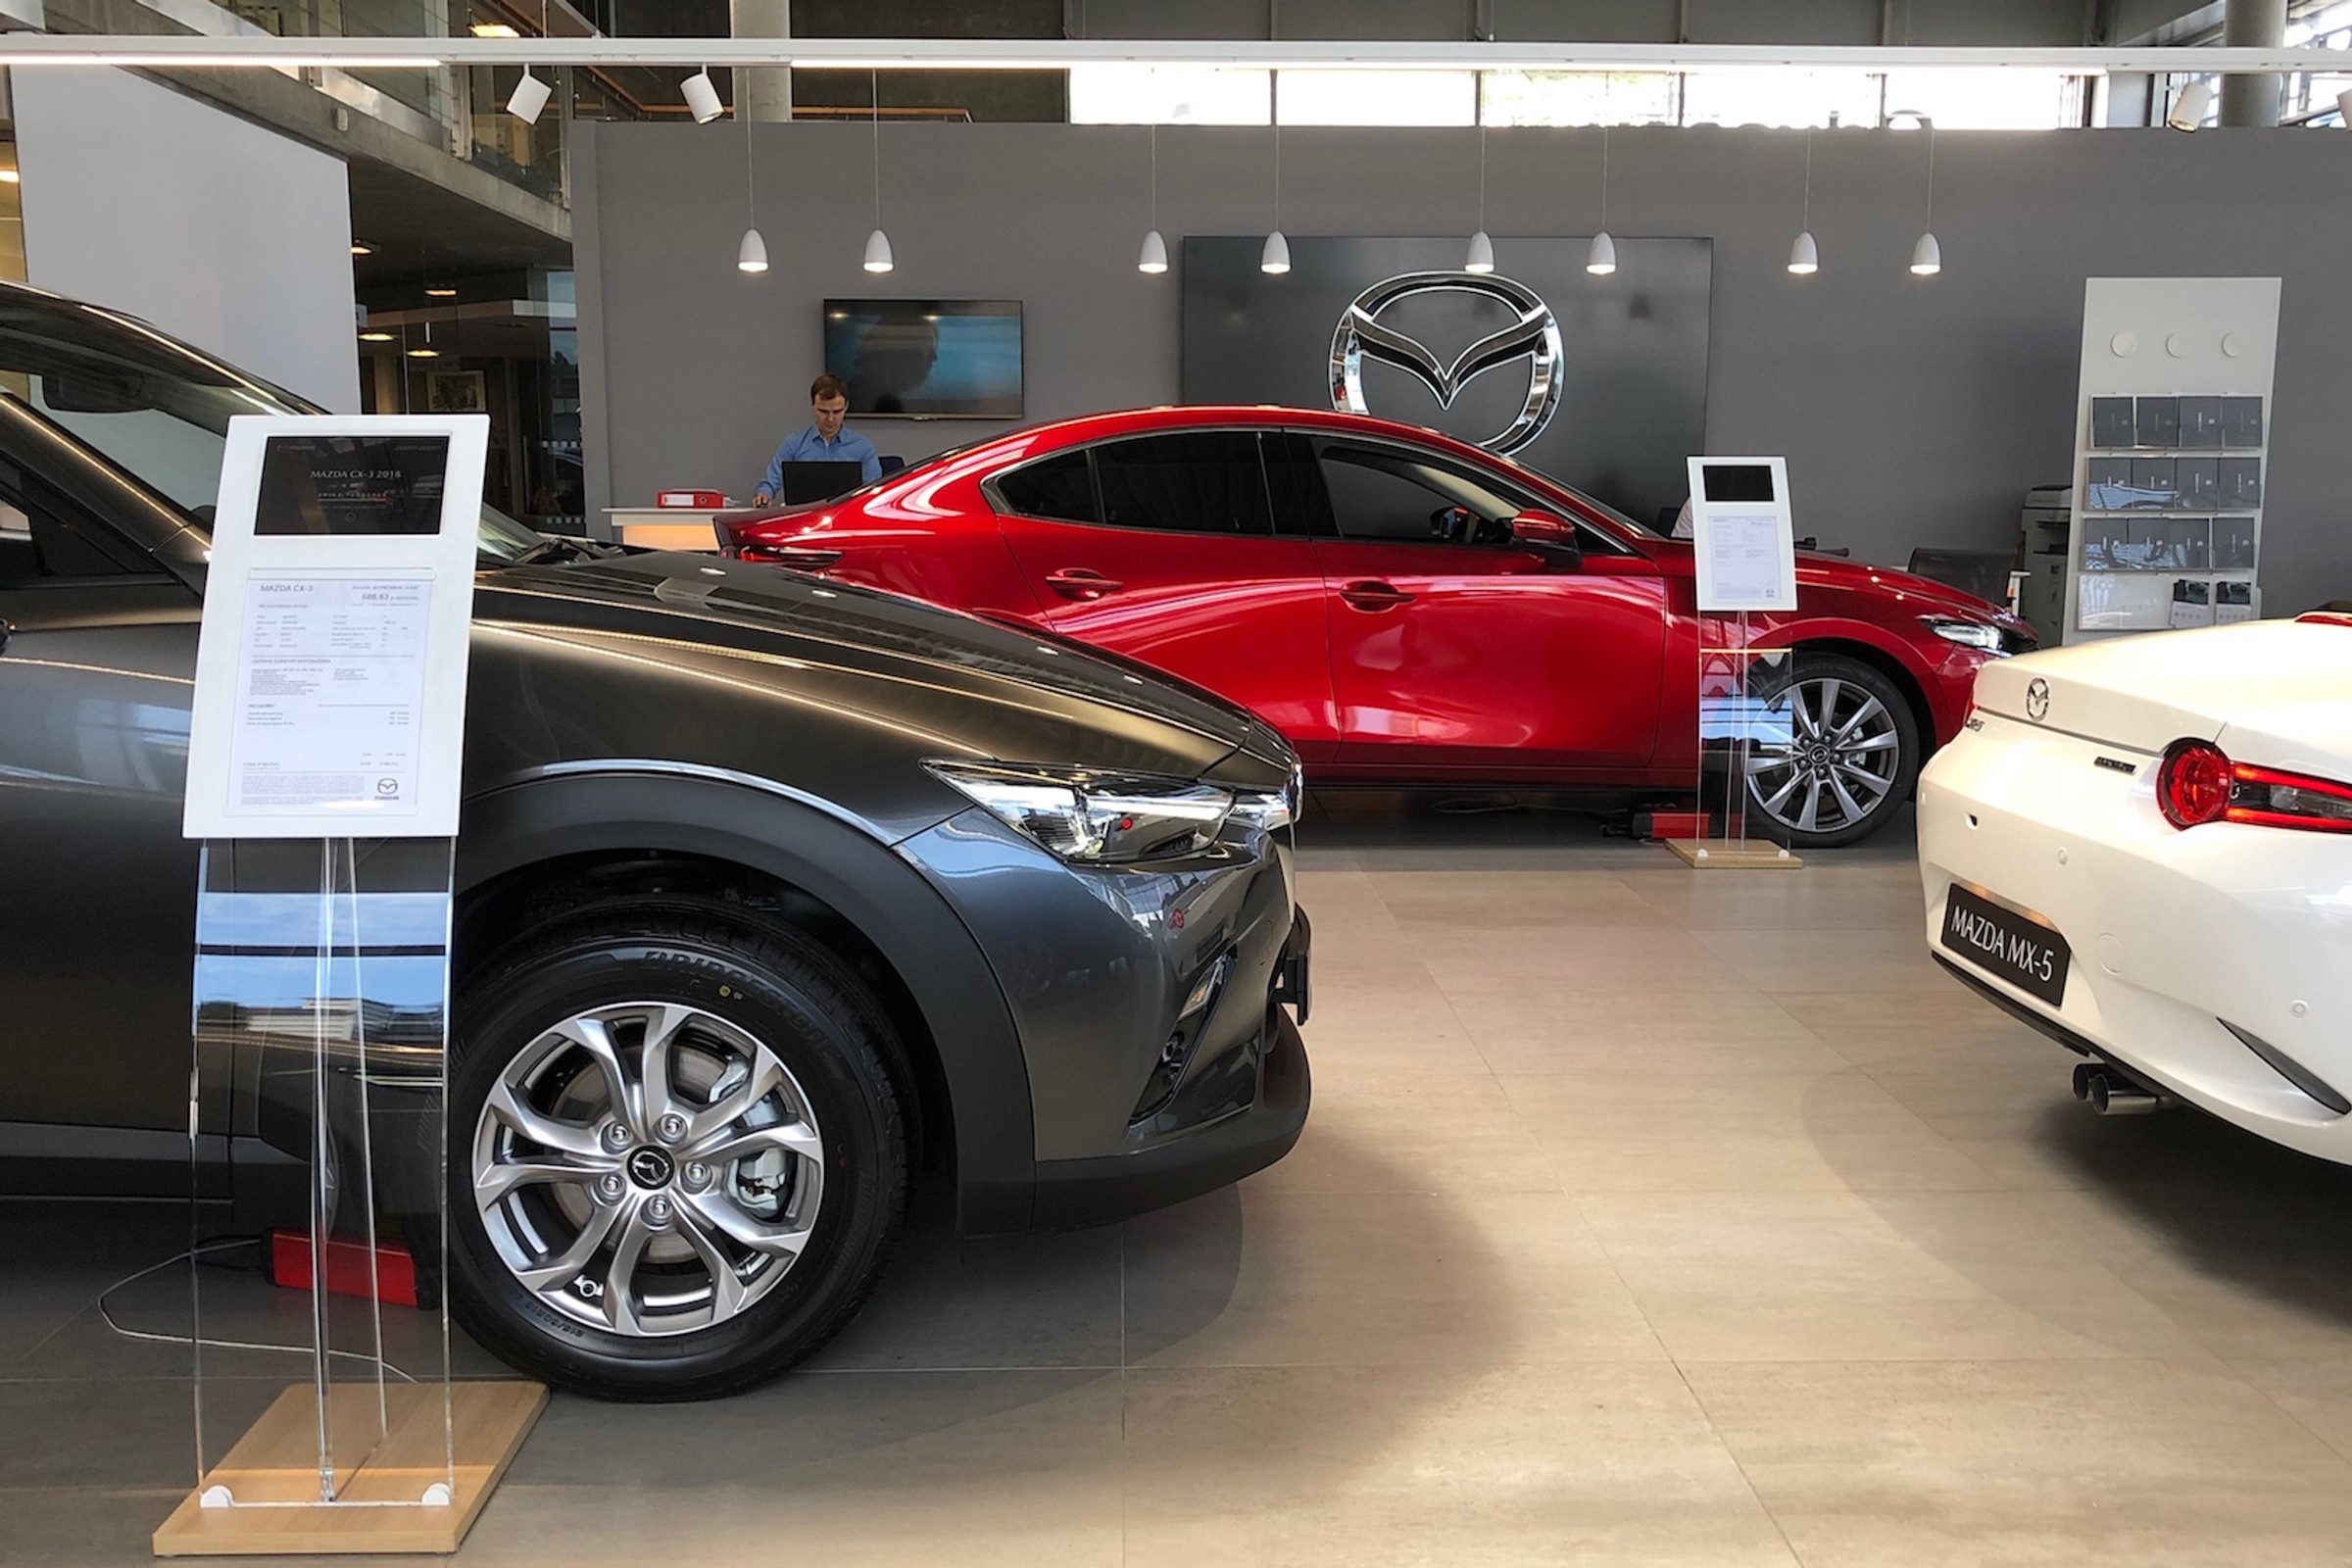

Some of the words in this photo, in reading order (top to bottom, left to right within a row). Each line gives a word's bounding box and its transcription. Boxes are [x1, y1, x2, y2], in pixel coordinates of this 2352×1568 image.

[311, 469, 348, 479] MAZDA
[349, 469, 374, 479] CX-3
[1951, 906, 2004, 958] MAZDA
[2007, 935, 2054, 981] MX-5
